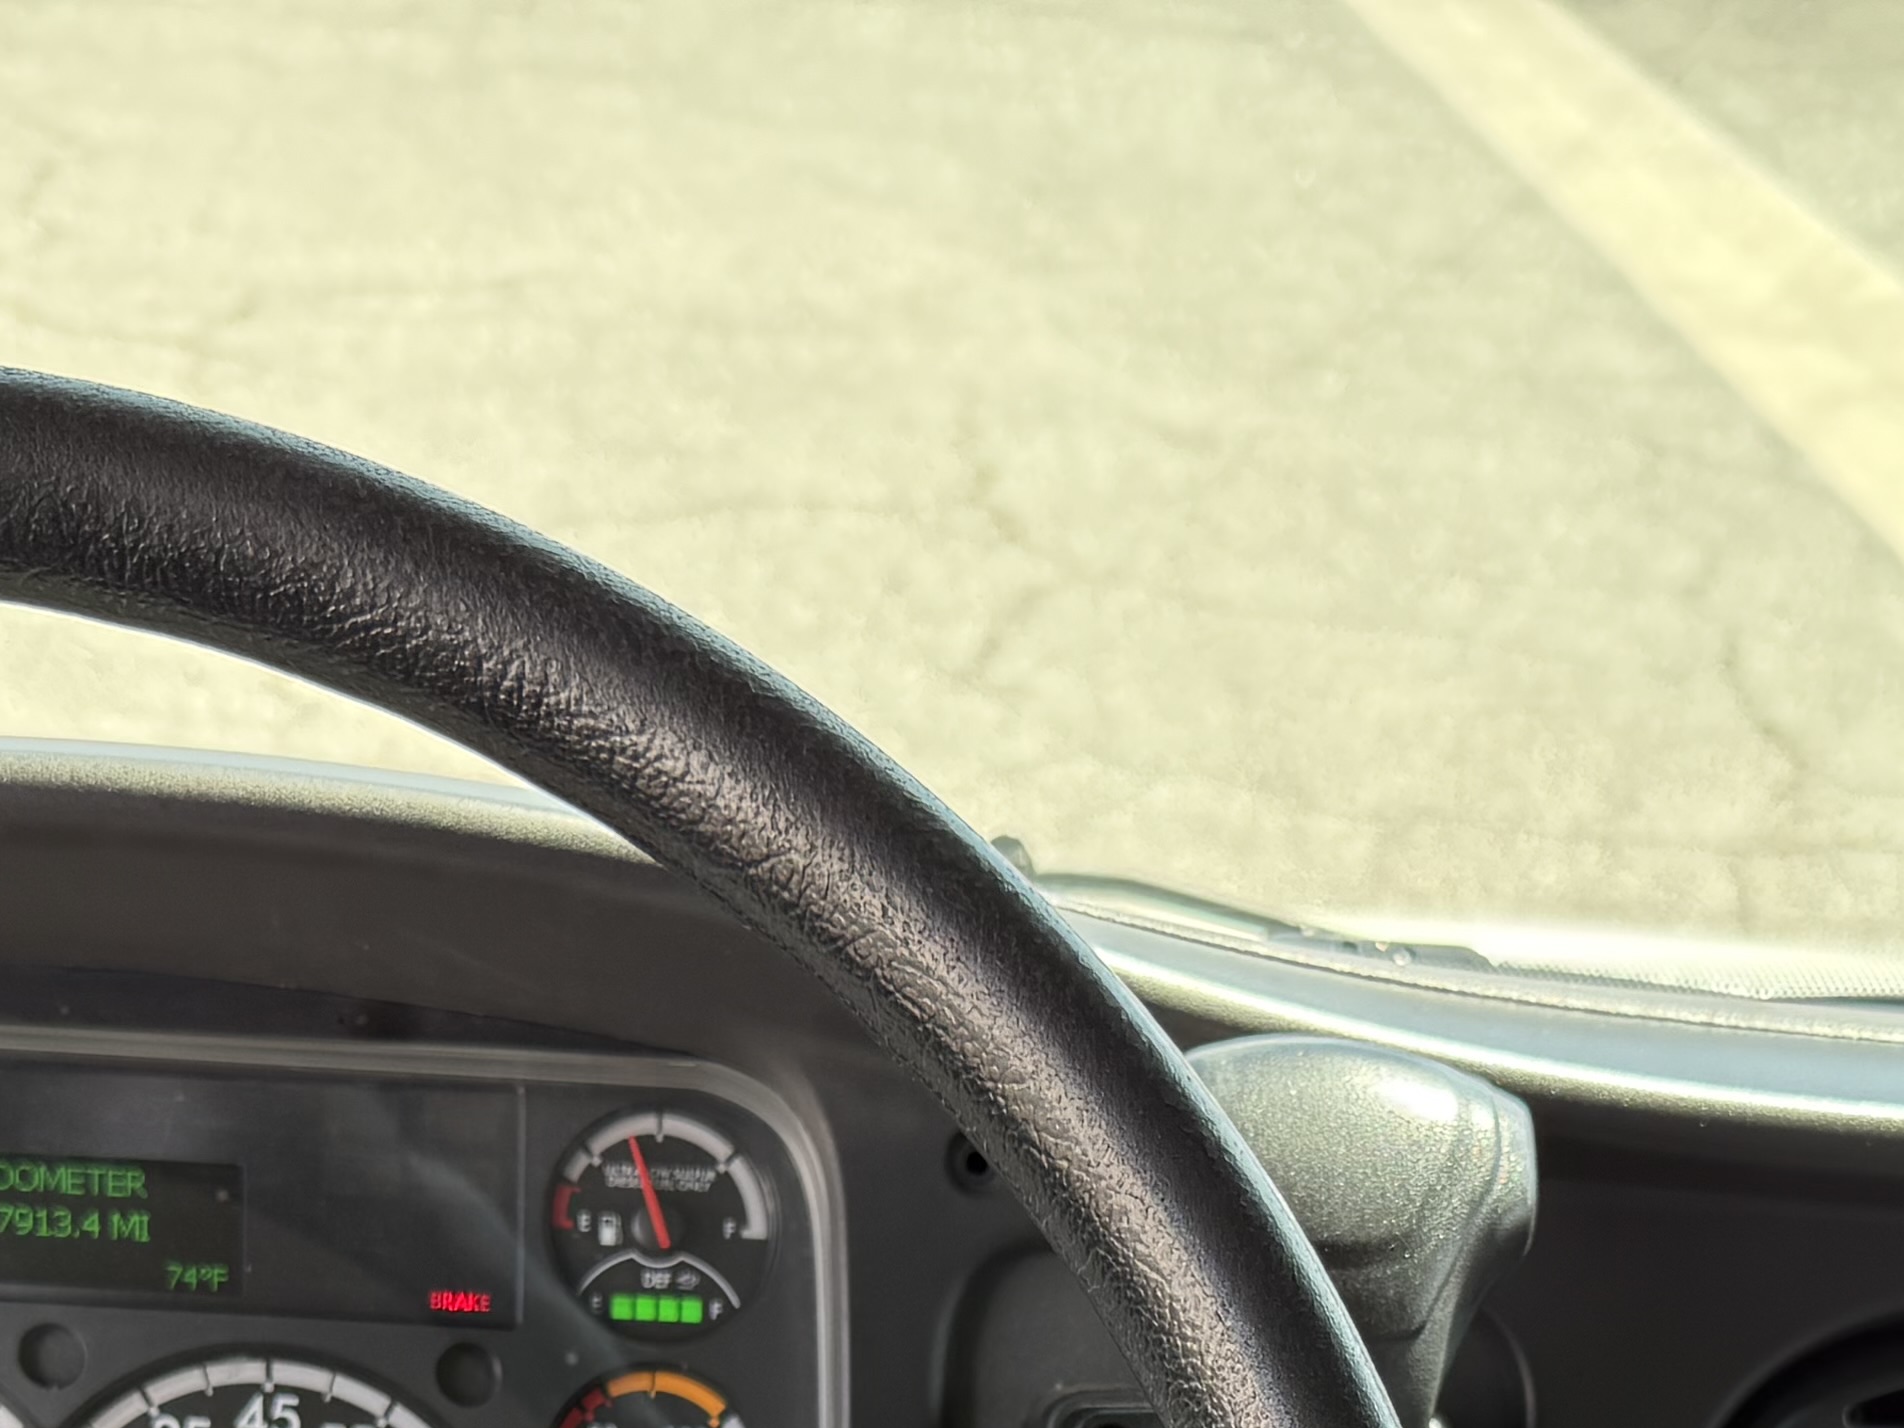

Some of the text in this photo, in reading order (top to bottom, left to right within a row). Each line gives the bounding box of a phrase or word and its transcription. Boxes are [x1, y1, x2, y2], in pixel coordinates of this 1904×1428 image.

[110, 1211, 151, 1243] MI
[577, 1209, 592, 1232] E
[723, 1216, 737, 1240] F
[428, 1290, 491, 1312] BRAKE
